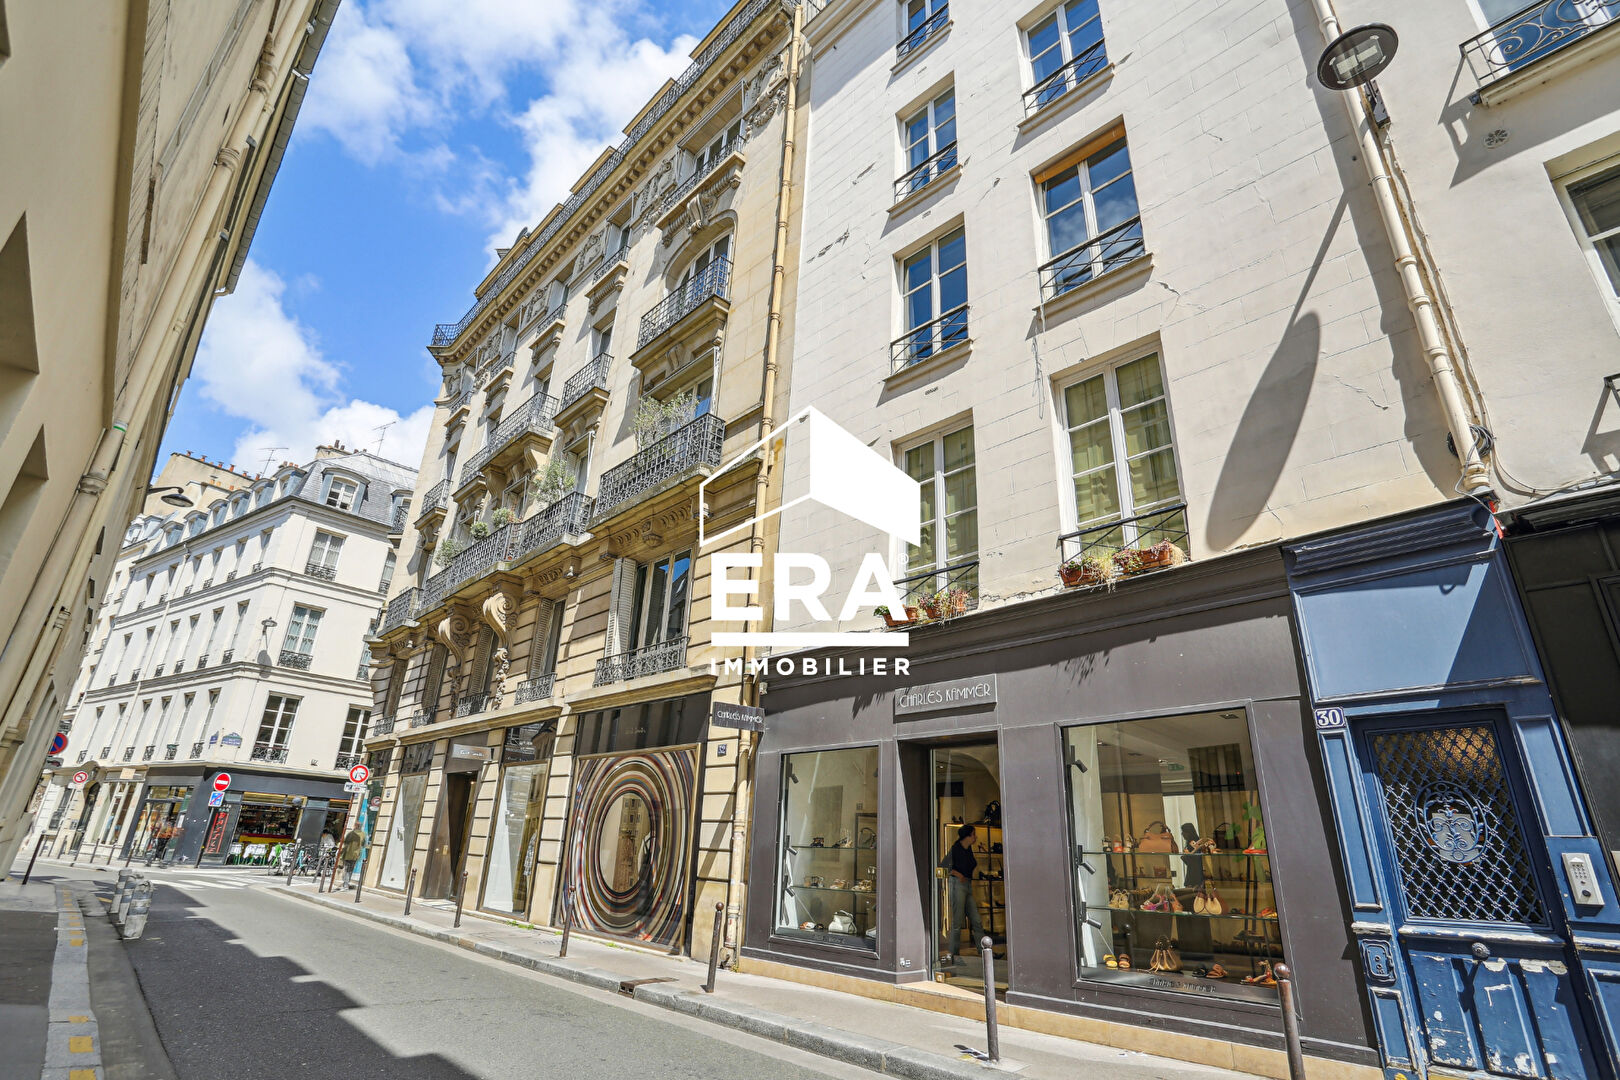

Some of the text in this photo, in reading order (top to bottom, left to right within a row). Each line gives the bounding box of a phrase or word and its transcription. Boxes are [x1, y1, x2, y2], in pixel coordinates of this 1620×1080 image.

[900, 683, 991, 708] CHARLES KAMMER
[1317, 709, 1340, 726] 30
